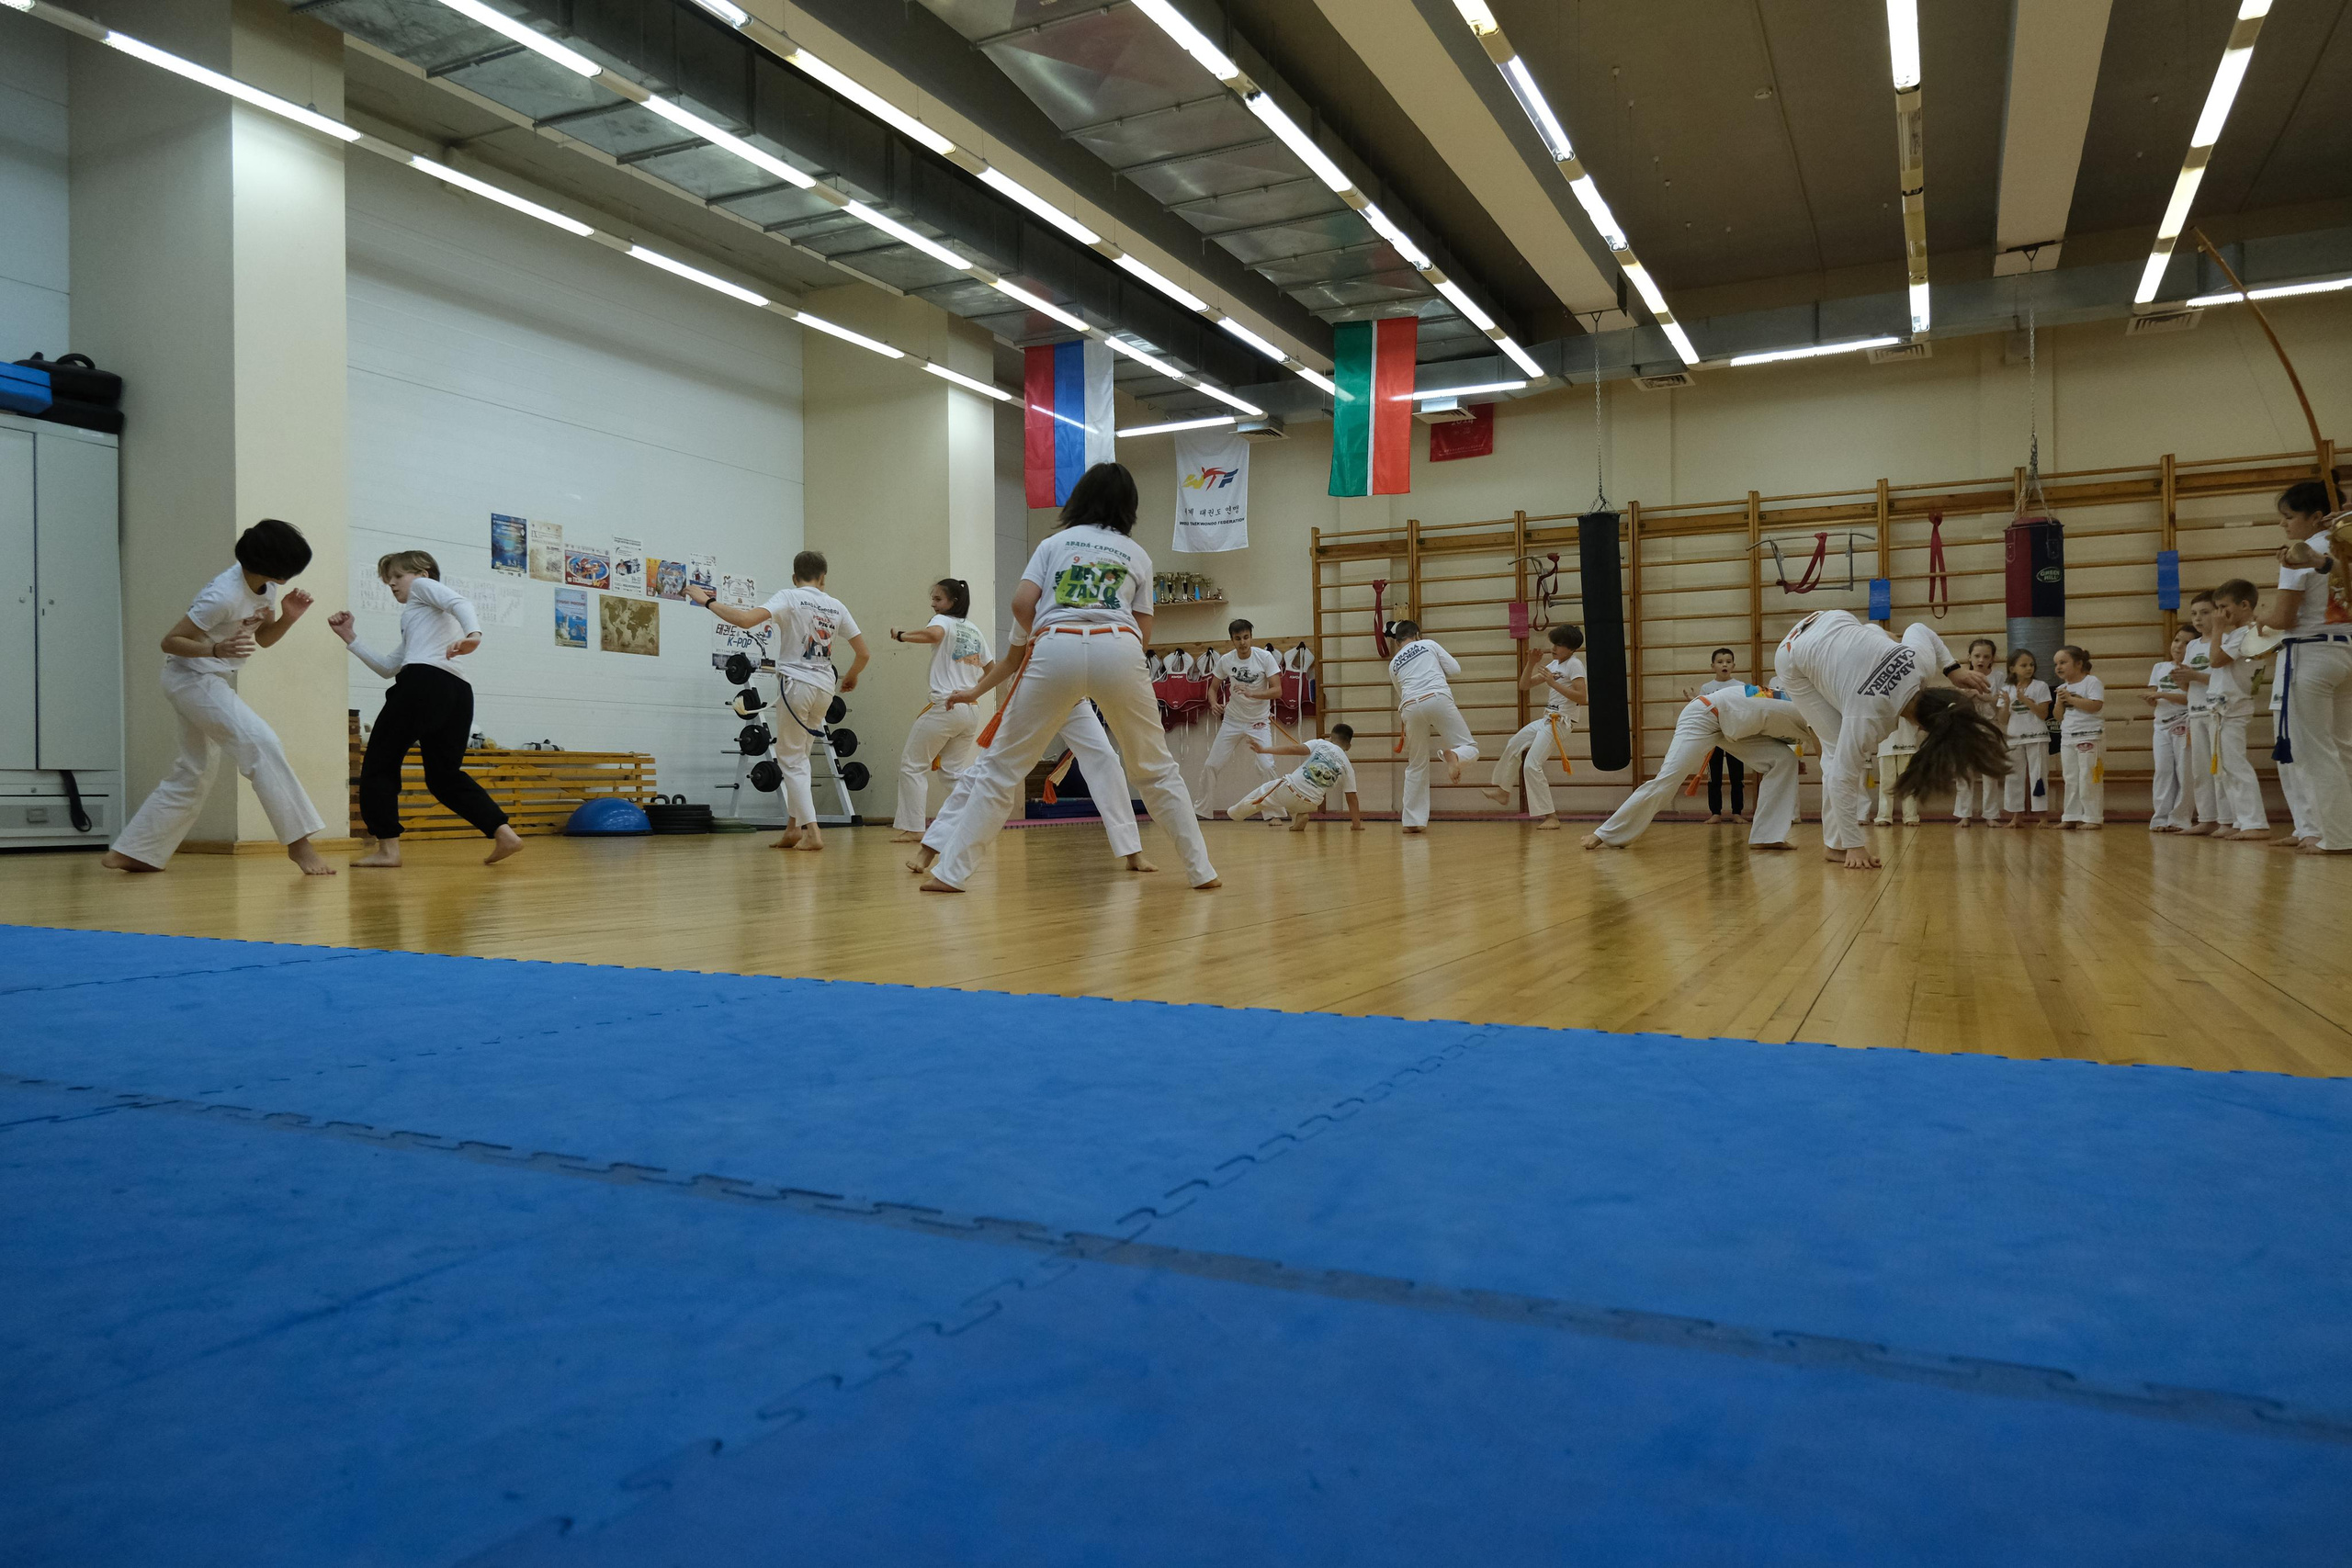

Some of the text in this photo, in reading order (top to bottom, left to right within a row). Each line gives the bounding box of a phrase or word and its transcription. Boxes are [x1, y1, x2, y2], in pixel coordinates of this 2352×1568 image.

[716, 624, 737, 637] 태권도
[727, 637, 752, 649] K-POP
[1864, 649, 1916, 696] CAPOEIRA
